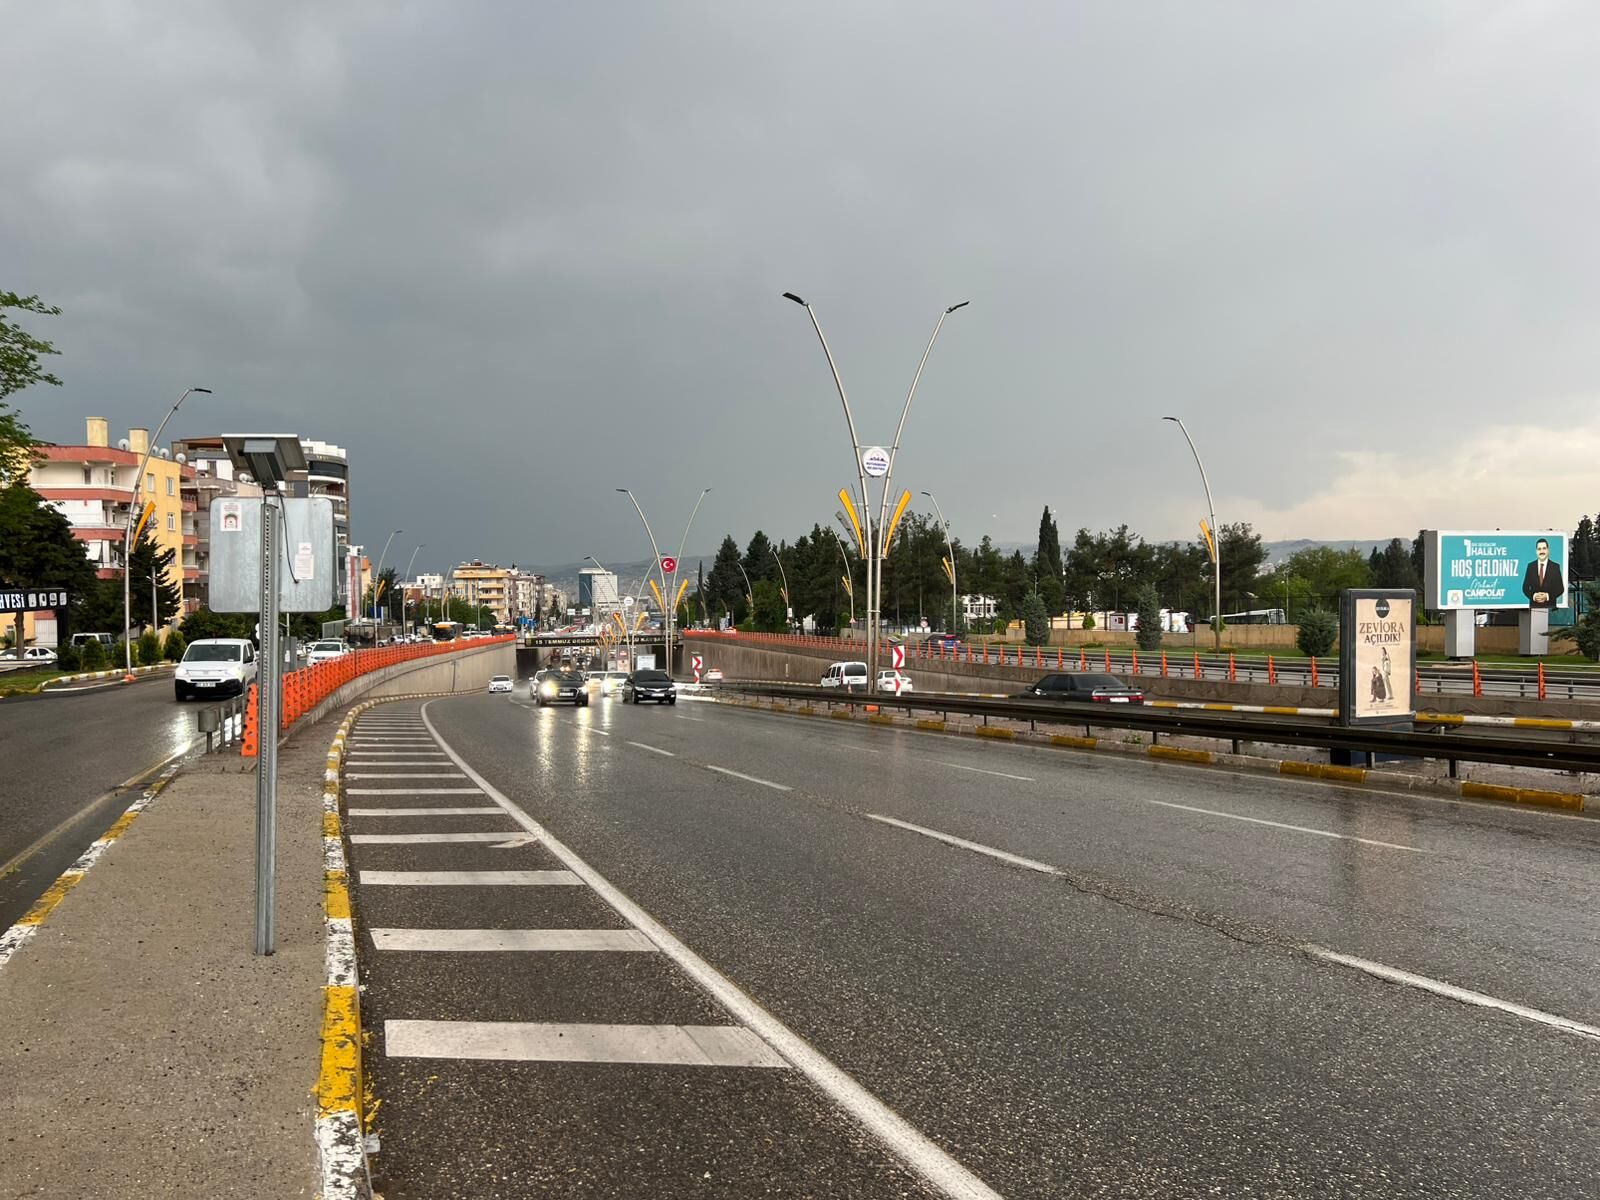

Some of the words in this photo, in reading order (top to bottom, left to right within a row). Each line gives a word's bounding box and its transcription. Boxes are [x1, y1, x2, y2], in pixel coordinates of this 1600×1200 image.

[1471, 546, 1507, 556] HALİLİYE
[1451, 559, 1473, 579] HOŞ
[1475, 559, 1519, 577] GELDİNİZ
[1359, 619, 1405, 634] ZEVİORA
[1364, 632, 1401, 645] AÇILDIK!
